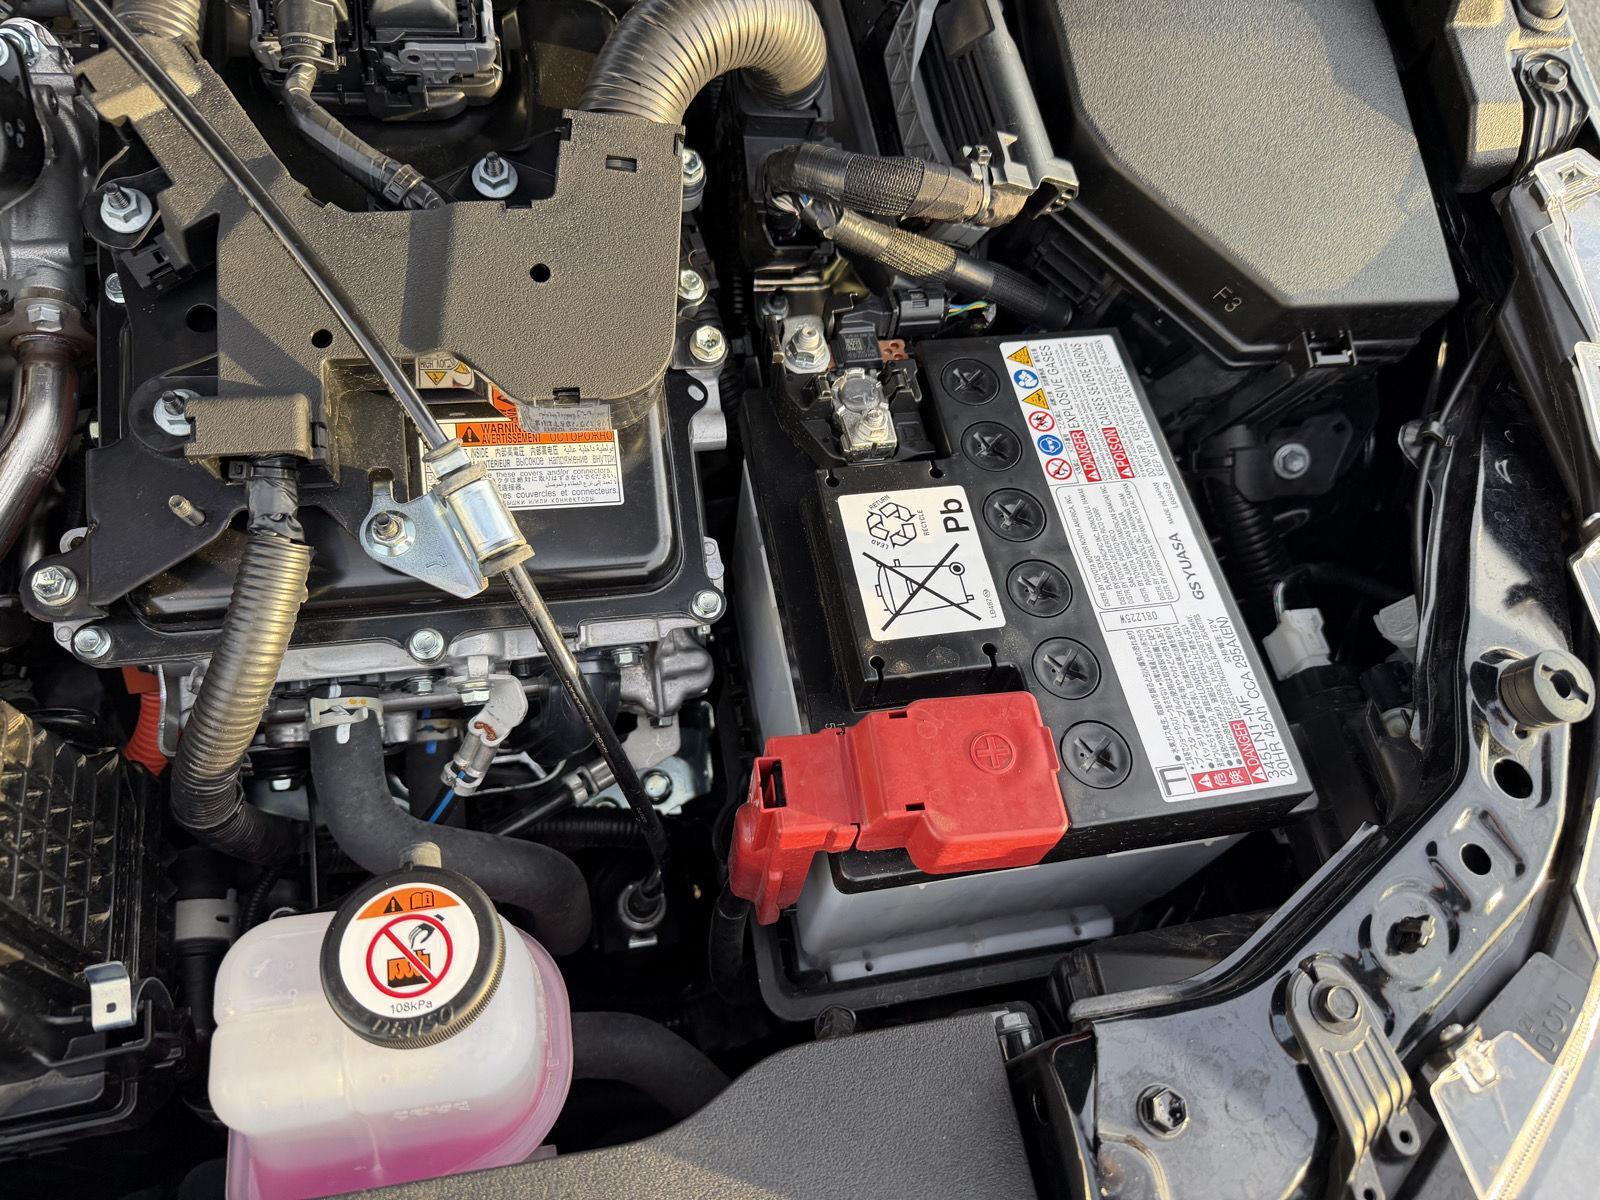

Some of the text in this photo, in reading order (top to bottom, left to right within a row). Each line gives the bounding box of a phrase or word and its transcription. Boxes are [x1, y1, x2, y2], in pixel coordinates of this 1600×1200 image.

[1037, 344, 1060, 375] GASES
[1050, 377, 1080, 428] EXPLOSIVE
[1068, 342, 1129, 467] POISON CAUSES SEVERE BURNS
[481, 424, 521, 434] WARNIN
[482, 432, 541, 444] AVERTISSEMENT
[1070, 431, 1096, 470] DANGER
[515, 489, 556, 498] couvercles
[916, 509, 929, 536] RECYCLE
[939, 498, 969, 533] Pb
[1167, 532, 1197, 581] YUASA
[1214, 615, 1293, 776] 20HR 45Ah CCA 295A(EN)
[1231, 721, 1260, 766] DANGER
[1235, 694, 1280, 779] 345LN1-MF
[370, 1005, 454, 1039] DENSO
[390, 999, 433, 1014] 108kPa
